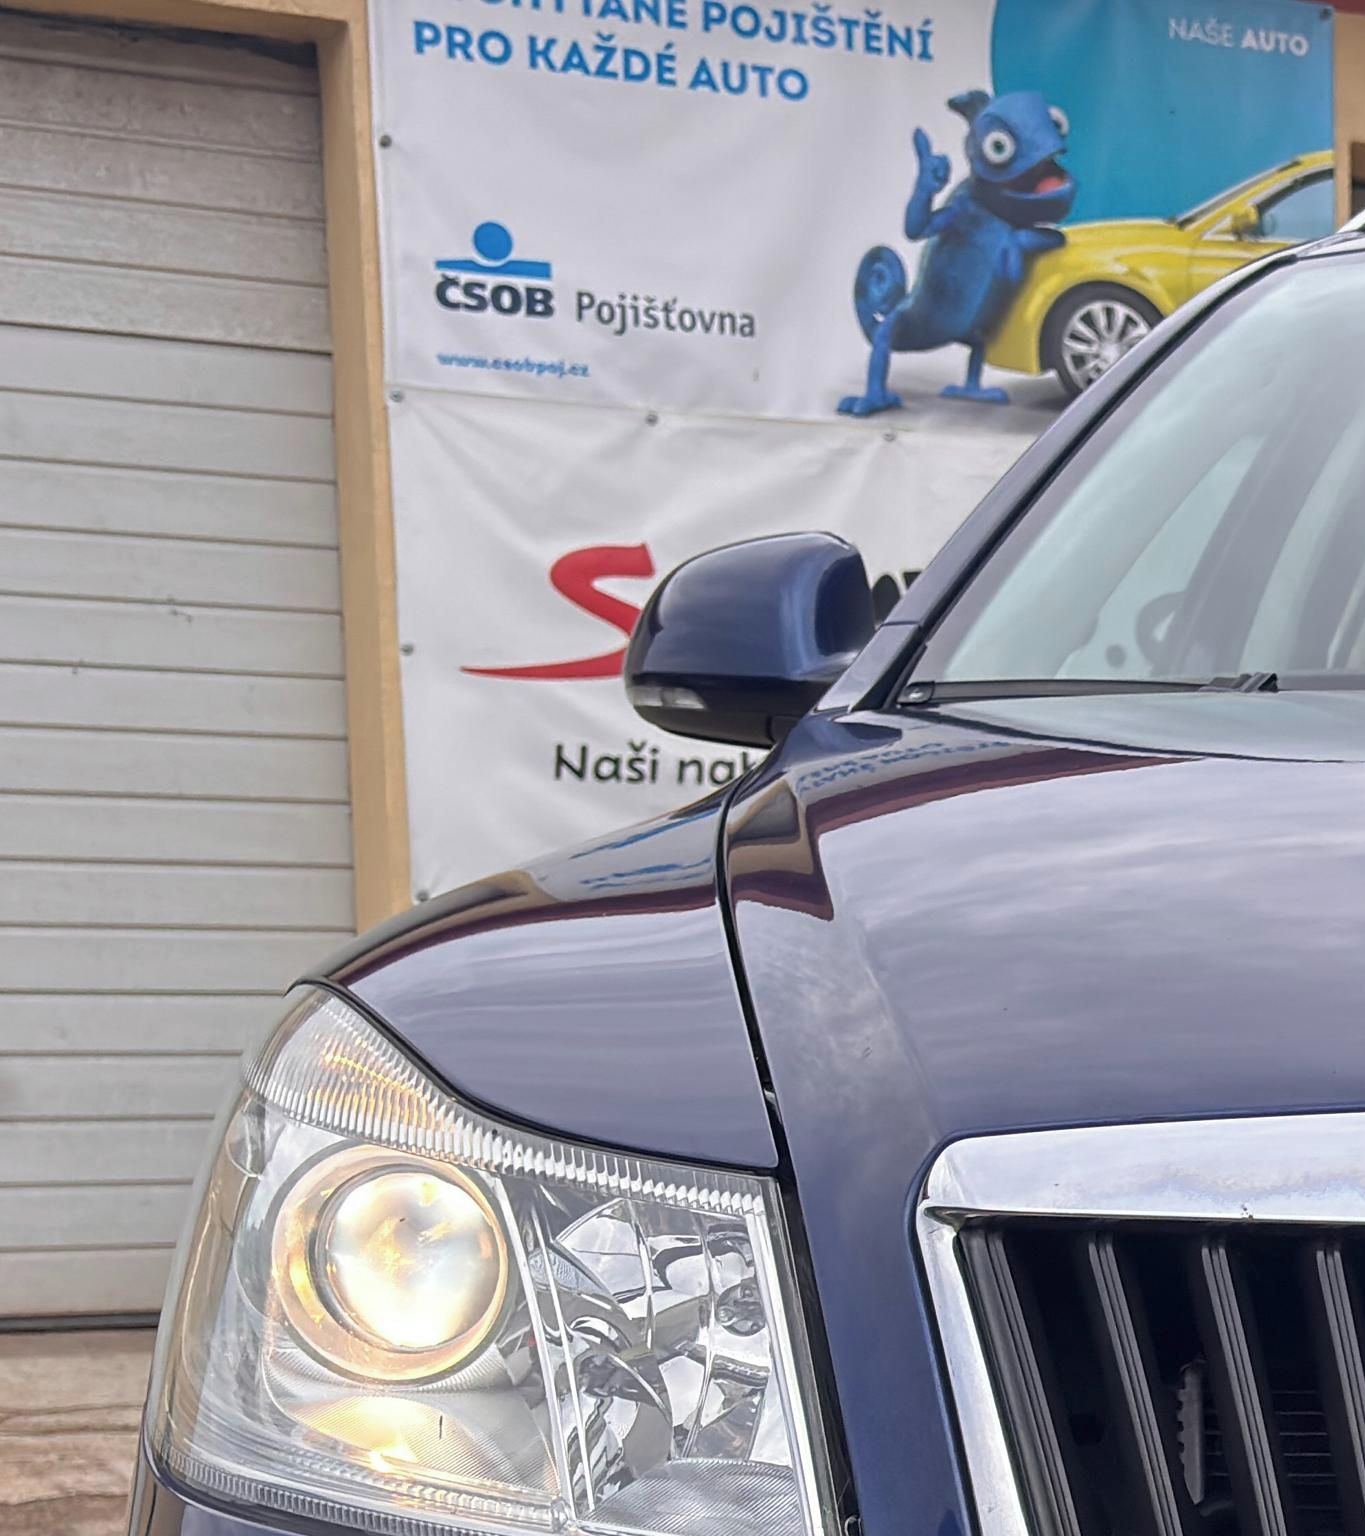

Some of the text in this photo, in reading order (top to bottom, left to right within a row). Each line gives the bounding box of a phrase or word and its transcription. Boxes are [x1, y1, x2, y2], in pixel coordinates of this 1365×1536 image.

[413, 20, 809, 102] PRO KAŽDÉ AUTO
[702, 0, 934, 62] POJIŠTĚNÍ
[1167, 16, 1309, 57] NAŠE AUTO
[435, 273, 756, 338] ČSOB Pojišťovna
[554, 739, 660, 784] Naši
